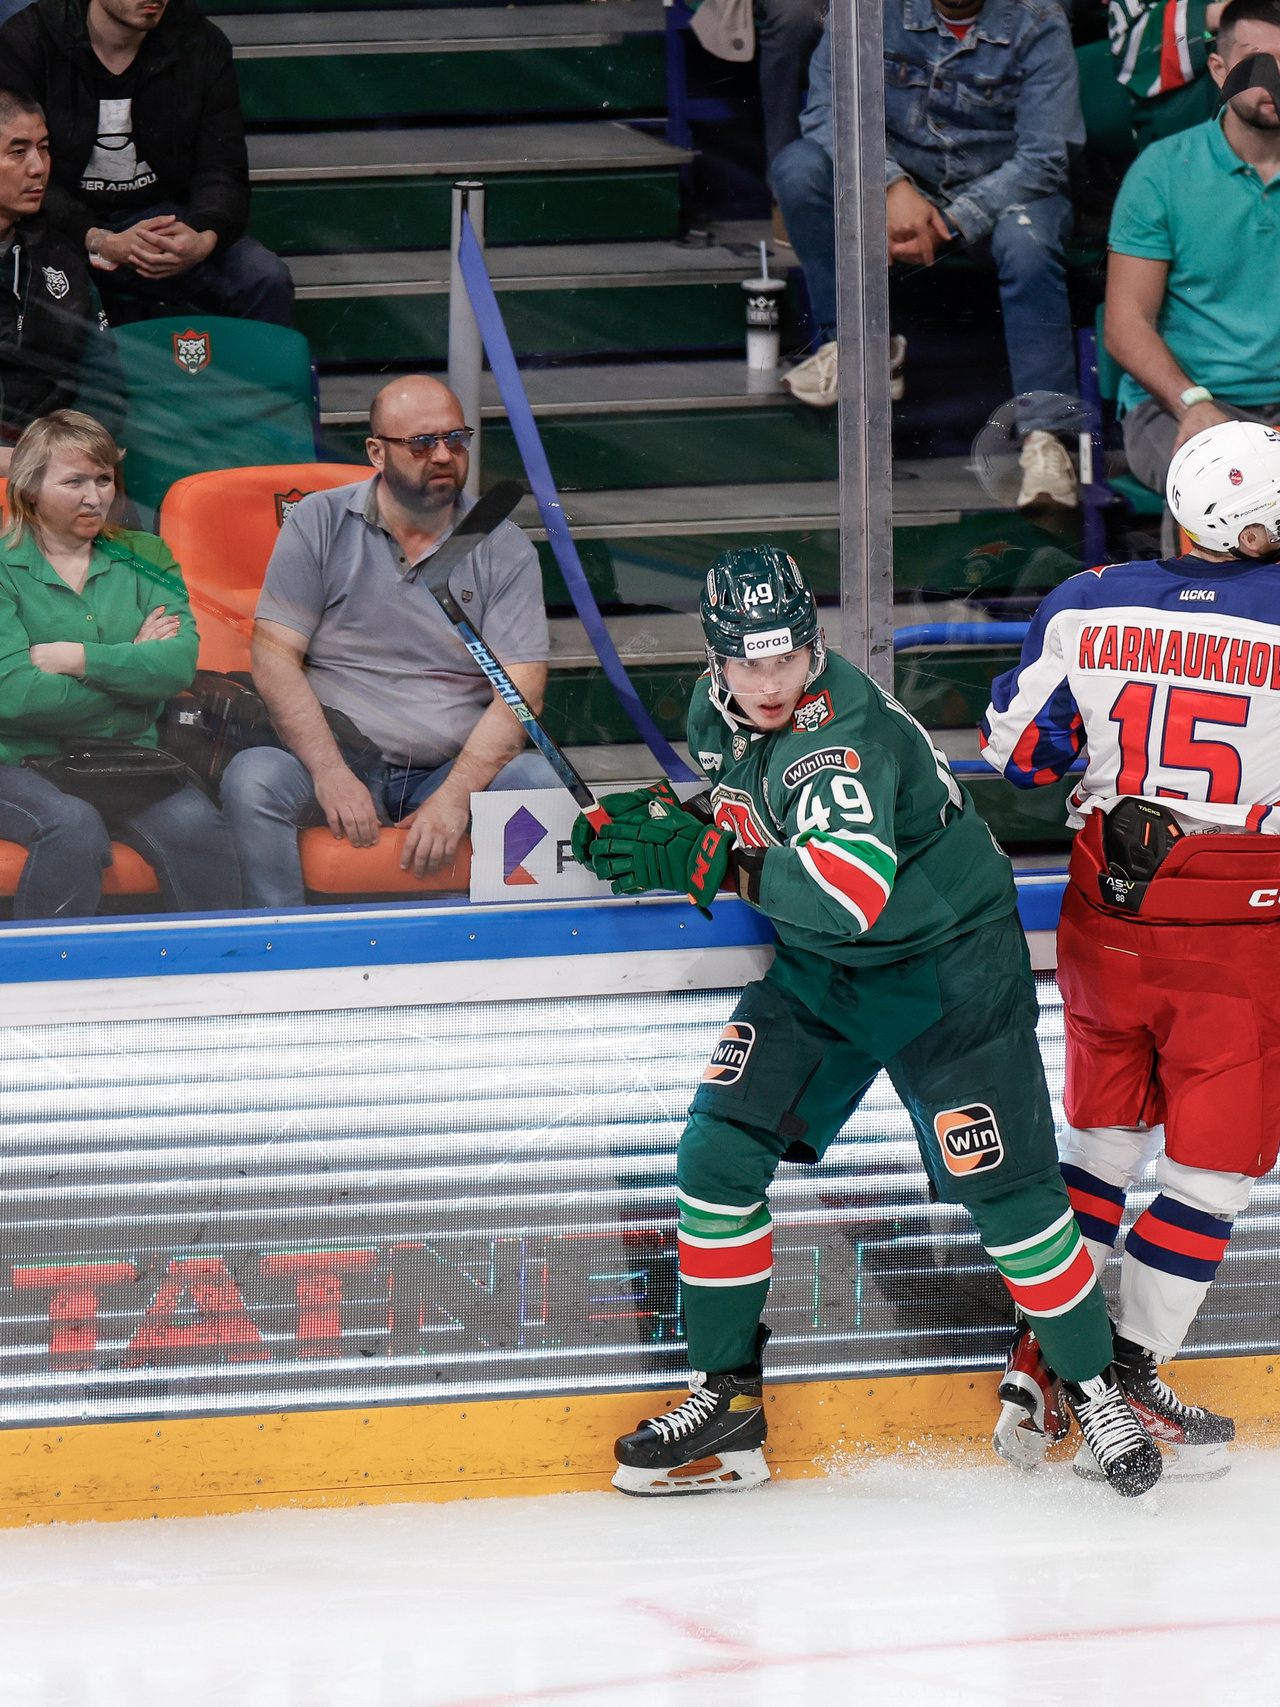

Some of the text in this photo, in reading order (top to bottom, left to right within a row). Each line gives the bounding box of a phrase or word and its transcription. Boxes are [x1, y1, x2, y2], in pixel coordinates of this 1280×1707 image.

[106, 173, 157, 191] ARMOU
[743, 583, 774, 607] 49
[1179, 589, 1216, 601] ЦСКА
[746, 635, 790, 651] согаз
[1110, 680, 1251, 805] 15
[797, 775, 875, 833] 49
[1138, 804, 1161, 817] TACKS
[1112, 886, 1128, 895] PRO
[713, 1043, 745, 1065] Win
[948, 1127, 997, 1153] Win
